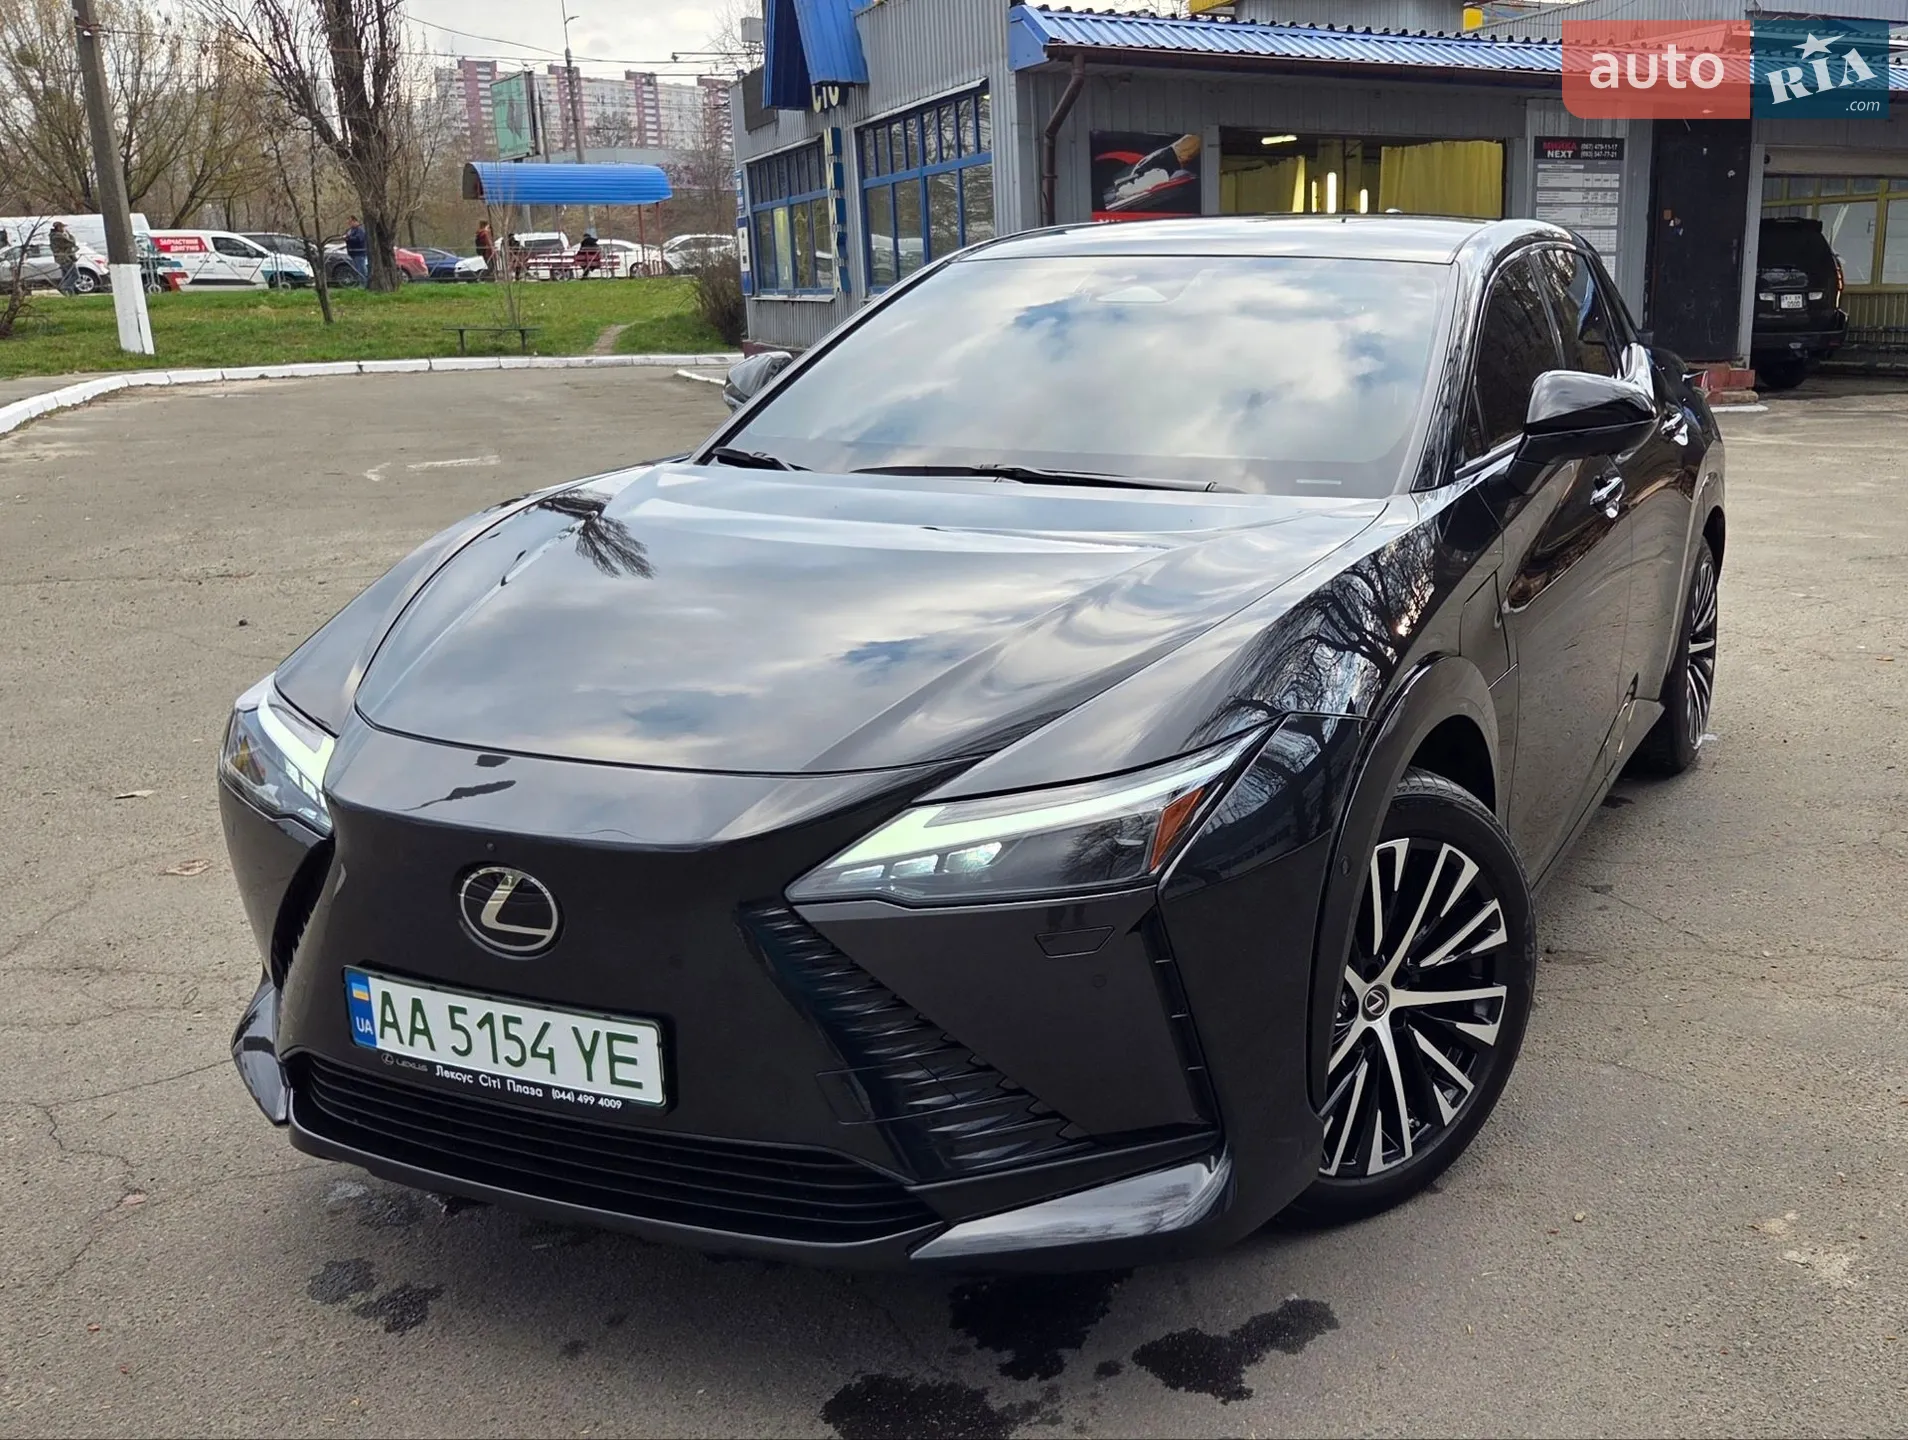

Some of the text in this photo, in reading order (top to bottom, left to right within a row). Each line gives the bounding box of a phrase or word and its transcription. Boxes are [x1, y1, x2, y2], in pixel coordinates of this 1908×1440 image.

[1547, 150, 1574, 158] NEXT
[355, 1016, 374, 1036] UA
[379, 990, 643, 1090] AA 5154 YE
[396, 1060, 429, 1072] LEXUS
[435, 1065, 623, 1110] Лексус Сіті Плаза (044) 499 4009
